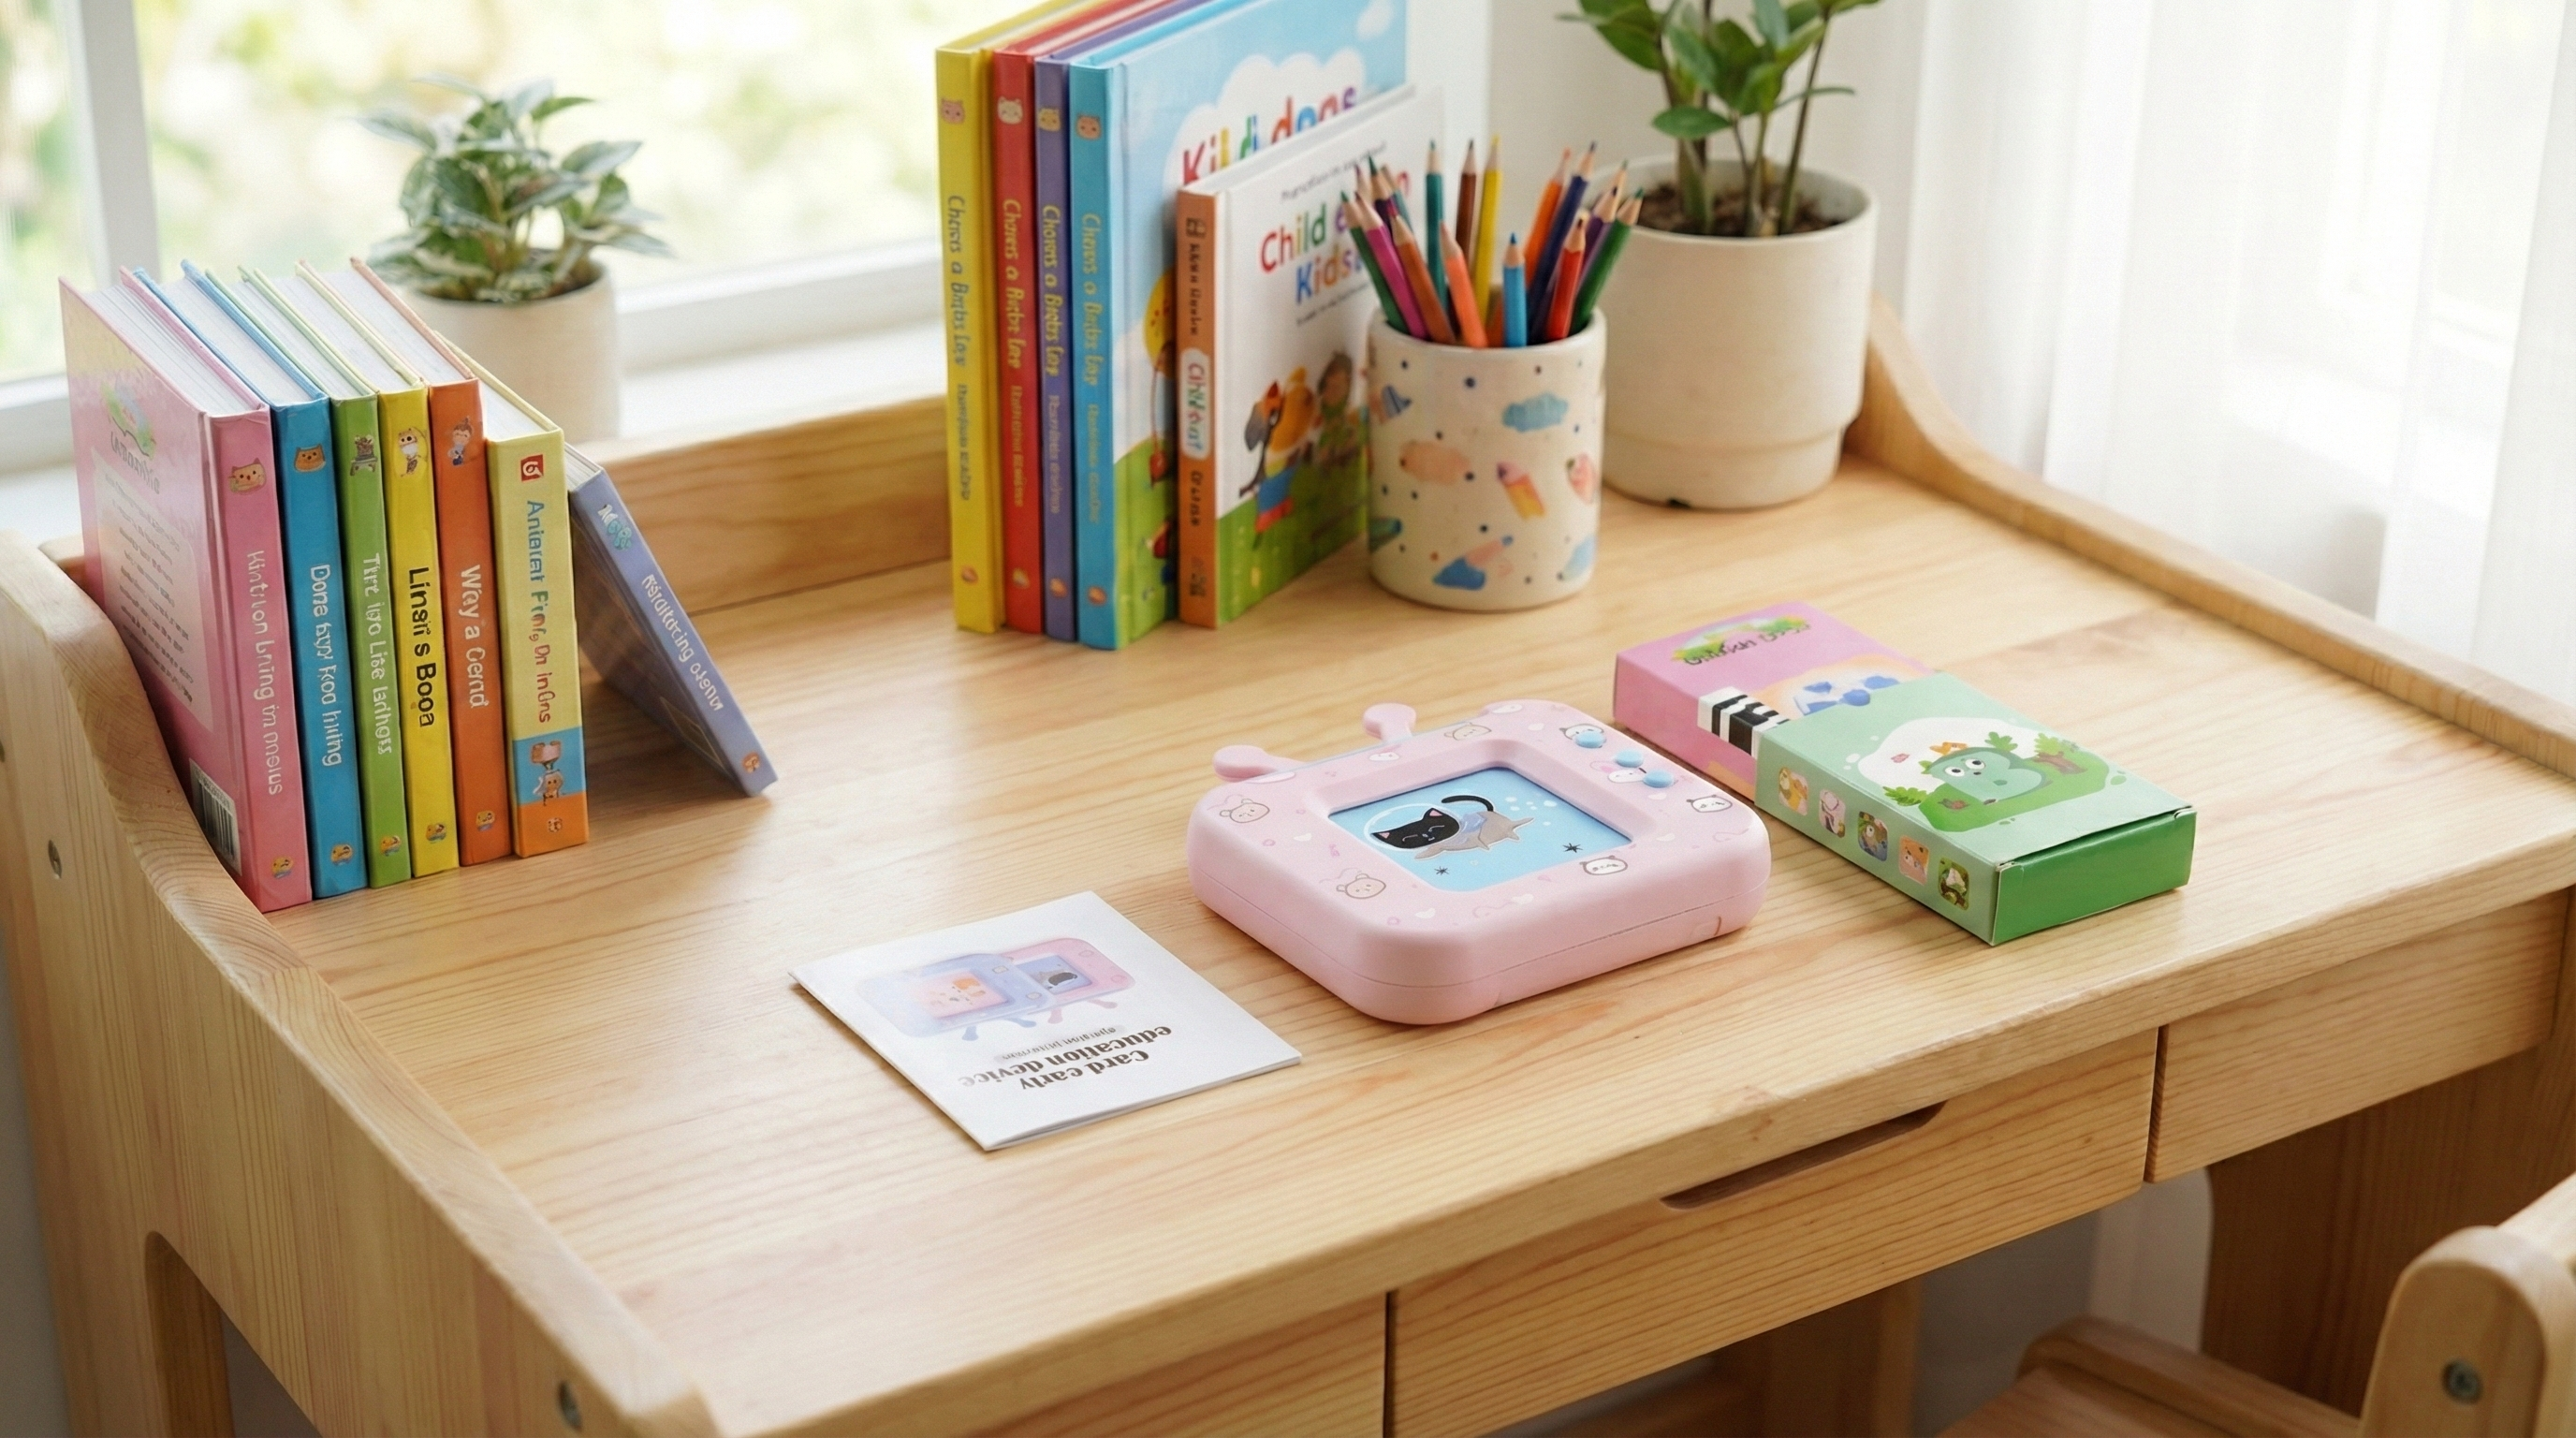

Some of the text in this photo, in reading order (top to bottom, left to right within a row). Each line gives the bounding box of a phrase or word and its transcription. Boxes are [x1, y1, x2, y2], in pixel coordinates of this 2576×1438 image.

[1260, 203, 1327, 274] Child
[465, 625, 480, 639] a
[1044, 1026, 1172, 1065] education
[959, 1060, 1044, 1087] device
[1020, 1049, 1149, 1090] Card early
